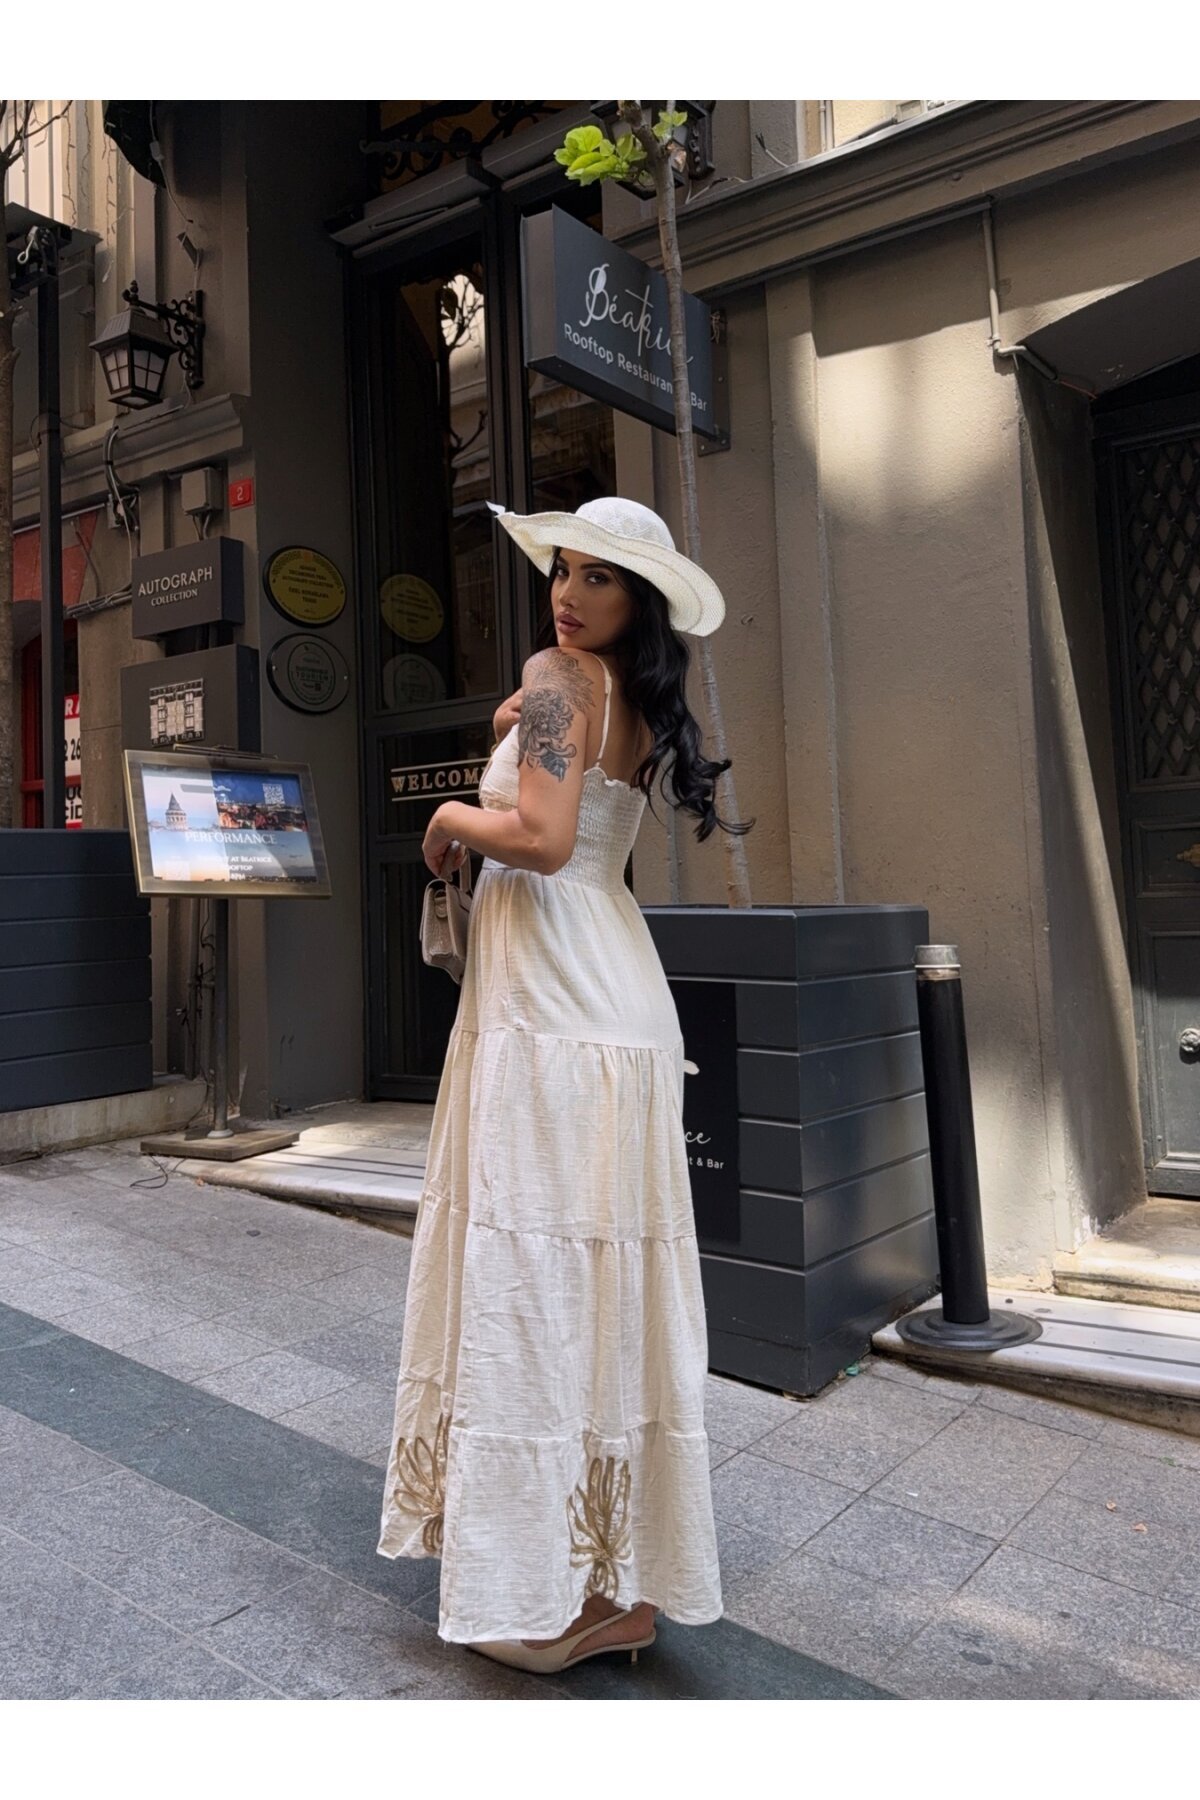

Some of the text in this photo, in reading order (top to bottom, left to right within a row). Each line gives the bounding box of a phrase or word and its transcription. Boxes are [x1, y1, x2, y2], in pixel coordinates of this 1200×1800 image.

[579, 263, 694, 363] Béatri
[564, 323, 708, 411] Rooftop Restauran Bar
[236, 486, 244, 501] 2
[138, 566, 213, 597] AUTOGRAPH
[150, 588, 198, 607] COLLECTION
[390, 766, 484, 793] WELCOM
[184, 831, 278, 845] PERFORMANCE
[696, 1157, 703, 1167] &
[706, 1158, 724, 1169] Bar
